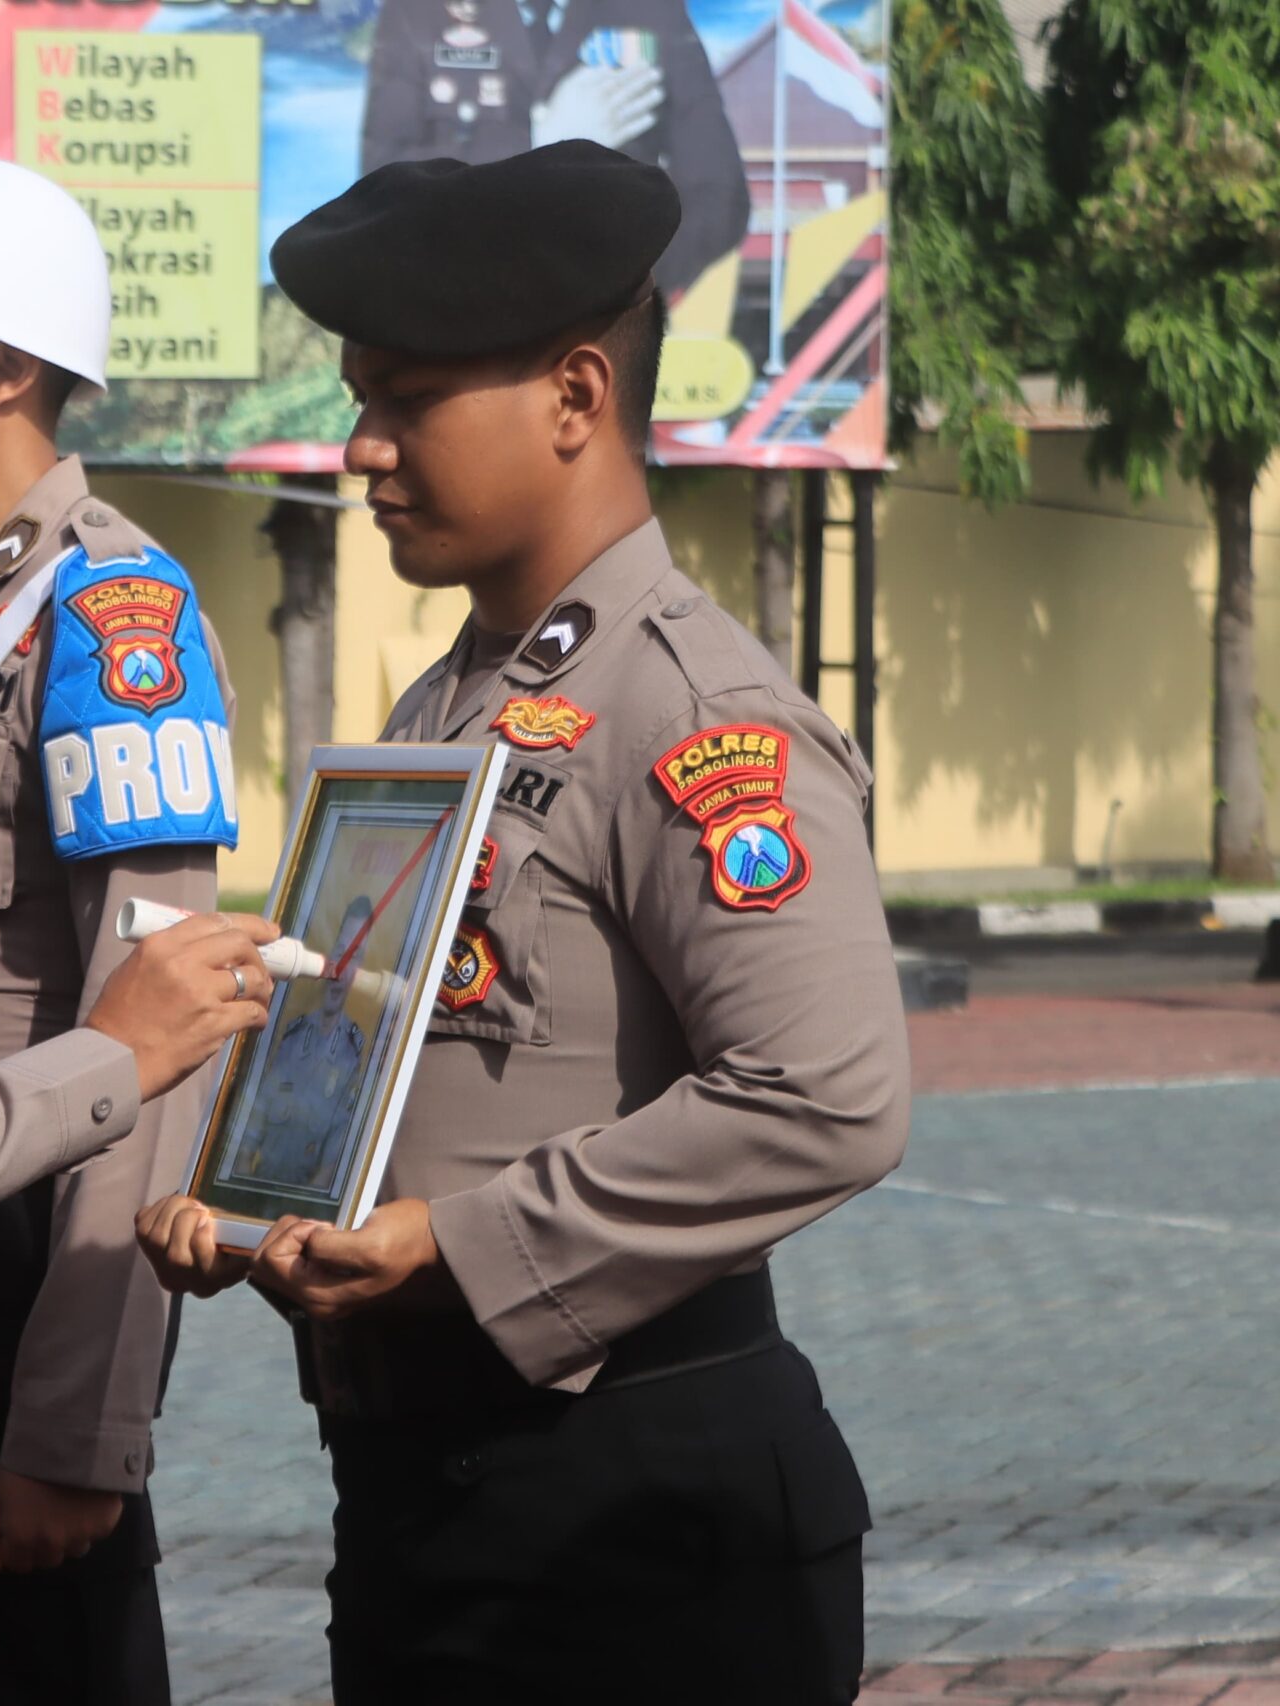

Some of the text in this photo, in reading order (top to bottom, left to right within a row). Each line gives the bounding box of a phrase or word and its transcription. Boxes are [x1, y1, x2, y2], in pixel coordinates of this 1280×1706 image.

[36, 44, 197, 88] Wilayah
[37, 88, 157, 122] Bebas
[36, 132, 192, 175] Korupsi
[81, 197, 196, 241] layah
[111, 284, 160, 318] sih
[112, 327, 218, 370] ayani
[83, 583, 175, 606] POLRES
[89, 593, 172, 615] PROBOLINGGO
[104, 614, 165, 631] JAWA TIMUR
[665, 733, 778, 783] POLRES
[677, 754, 776, 792] PROBOLINGGO
[698, 781, 775, 815] JAWA TIMUR
